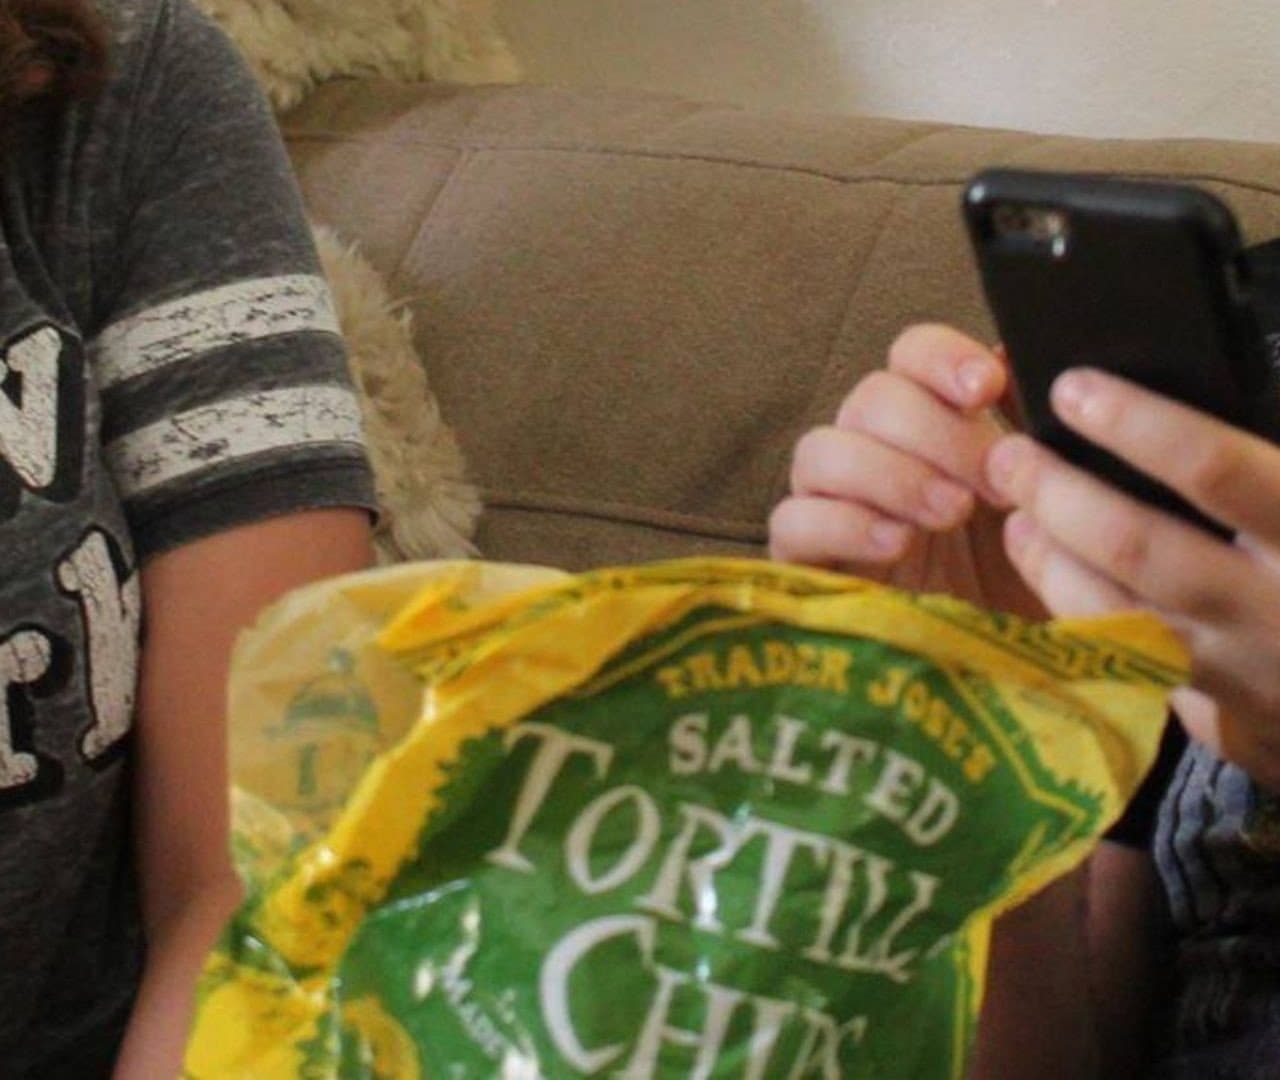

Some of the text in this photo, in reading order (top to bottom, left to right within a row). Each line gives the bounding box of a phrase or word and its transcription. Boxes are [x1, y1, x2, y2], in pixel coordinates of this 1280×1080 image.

[656, 639, 854, 699] TRADER
[669, 713, 960, 846] SALTED
[484, 722, 948, 983] TORTILL
